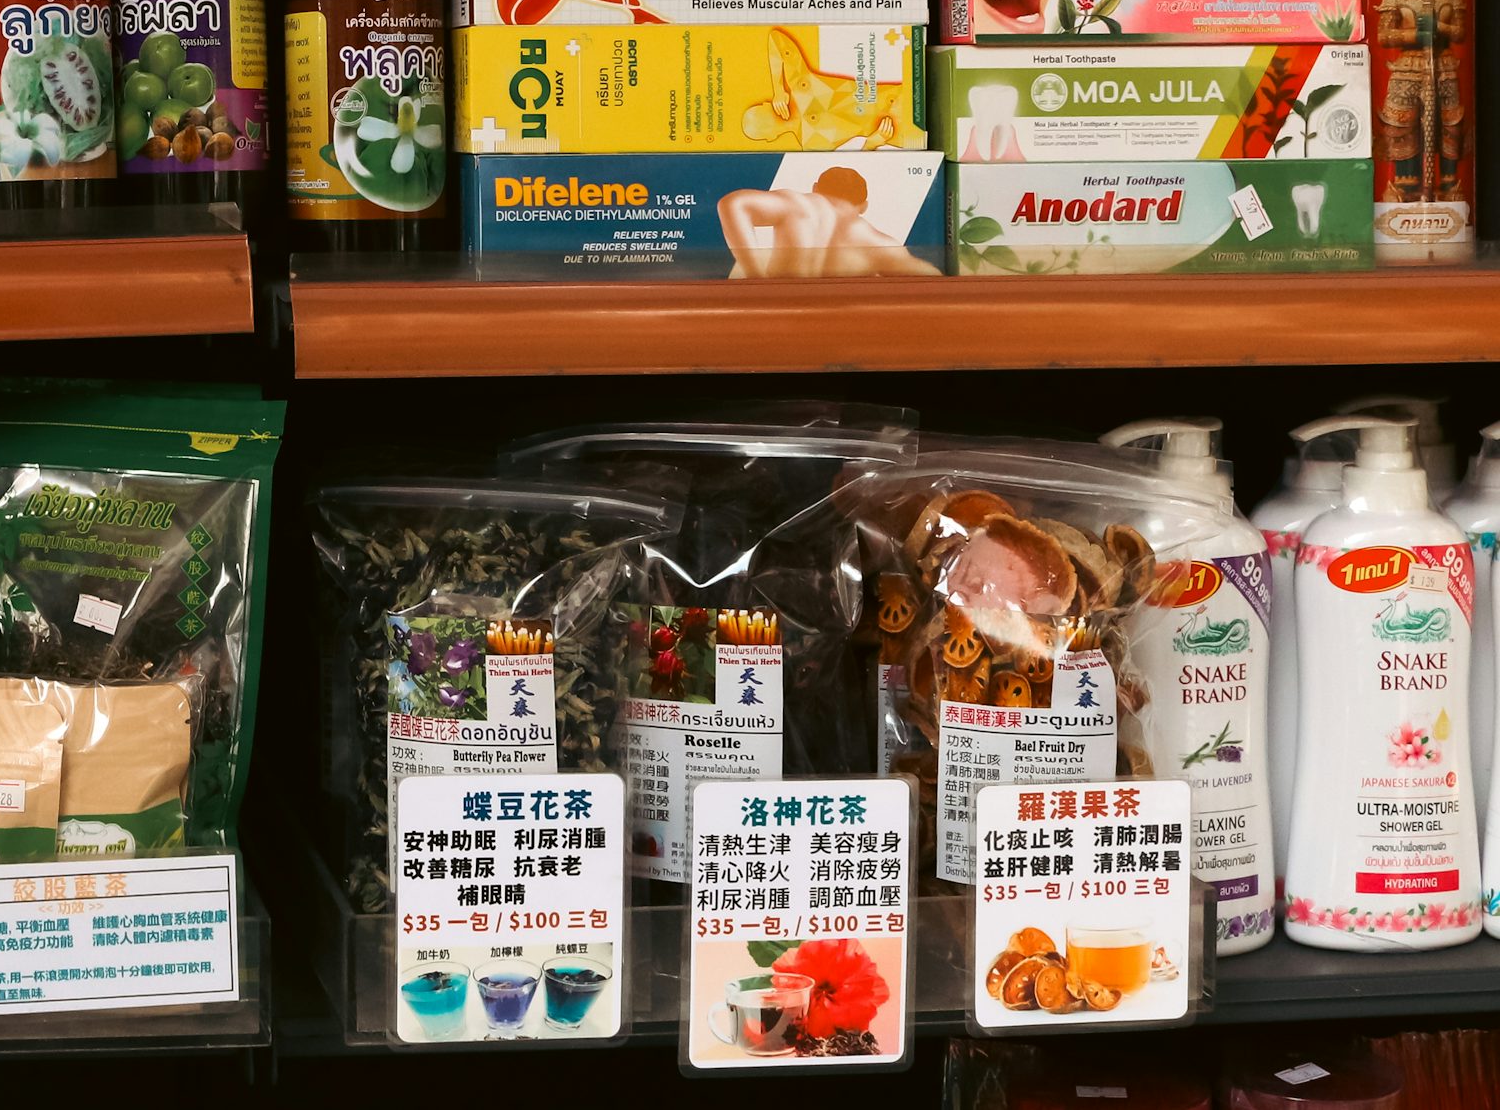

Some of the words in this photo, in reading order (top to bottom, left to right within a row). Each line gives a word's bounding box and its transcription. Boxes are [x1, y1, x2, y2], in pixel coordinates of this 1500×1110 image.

[1033, 55, 1063, 63] Herbal
[1065, 55, 1116, 65] Toothpaste
[1331, 51, 1364, 60] Original
[1073, 80, 1141, 103] MOA
[1150, 80, 1225, 103] JULA
[907, 167, 923, 176] 100
[927, 169, 932, 178] g
[495, 177, 647, 207] Difelene
[655, 195, 671, 206] 1%
[675, 195, 696, 205] GEL
[496, 209, 572, 221] DICLOFENAC
[575, 209, 691, 220] DIETHYLAMMONIUM
[1011, 190, 1184, 225] Anodard
[583, 243, 626, 251] REDUCES
[630, 242, 677, 251] SWELLING
[197, 434, 232, 447] ZIPPER
[718, 657, 740, 665] Thien
[760, 658, 781, 666] Herbs
[1377, 650, 1448, 672] SNAKE
[1380, 674, 1448, 691] BRAND
[945, 705, 1023, 729] 泰國羅漢果
[685, 735, 741, 750] Roselle
[1015, 740, 1036, 752] Bael
[1038, 740, 1065, 753] Fruit
[1068, 742, 1086, 755] Dry
[453, 750, 494, 763] Butterfly
[496, 751, 512, 763] Pea
[514, 751, 546, 763] Flower
[1361, 775, 1410, 788] JAPANESE
[1412, 776, 1445, 788] SAKURA
[463, 790, 593, 821] 蝶豆花茶
[741, 795, 868, 827] 洛神花茶
[1018, 788, 1140, 821] 羅漢果茶
[1357, 799, 1459, 817] ULTRA-MOISTURE
[1380, 820, 1423, 832] SHOWER
[1426, 820, 1443, 832] GEL
[404, 830, 496, 852] 安神助眠
[514, 828, 606, 850] 利尿消腫
[699, 834, 792, 857] 清熱生津
[810, 831, 901, 855] 美容瘦身
[984, 828, 1074, 851] 化痰止咳
[1093, 824, 1182, 847] 清肺潤腸
[14, 873, 129, 902] 絞股藍茶
[983, 884, 1017, 902] $35
[1025, 882, 1061, 900] 一包
[1081, 880, 1127, 898] $100
[1134, 878, 1169, 895] 三包
[1384, 877, 1438, 890] HYDRATING
[417, 949, 450, 961] 加牛奶
